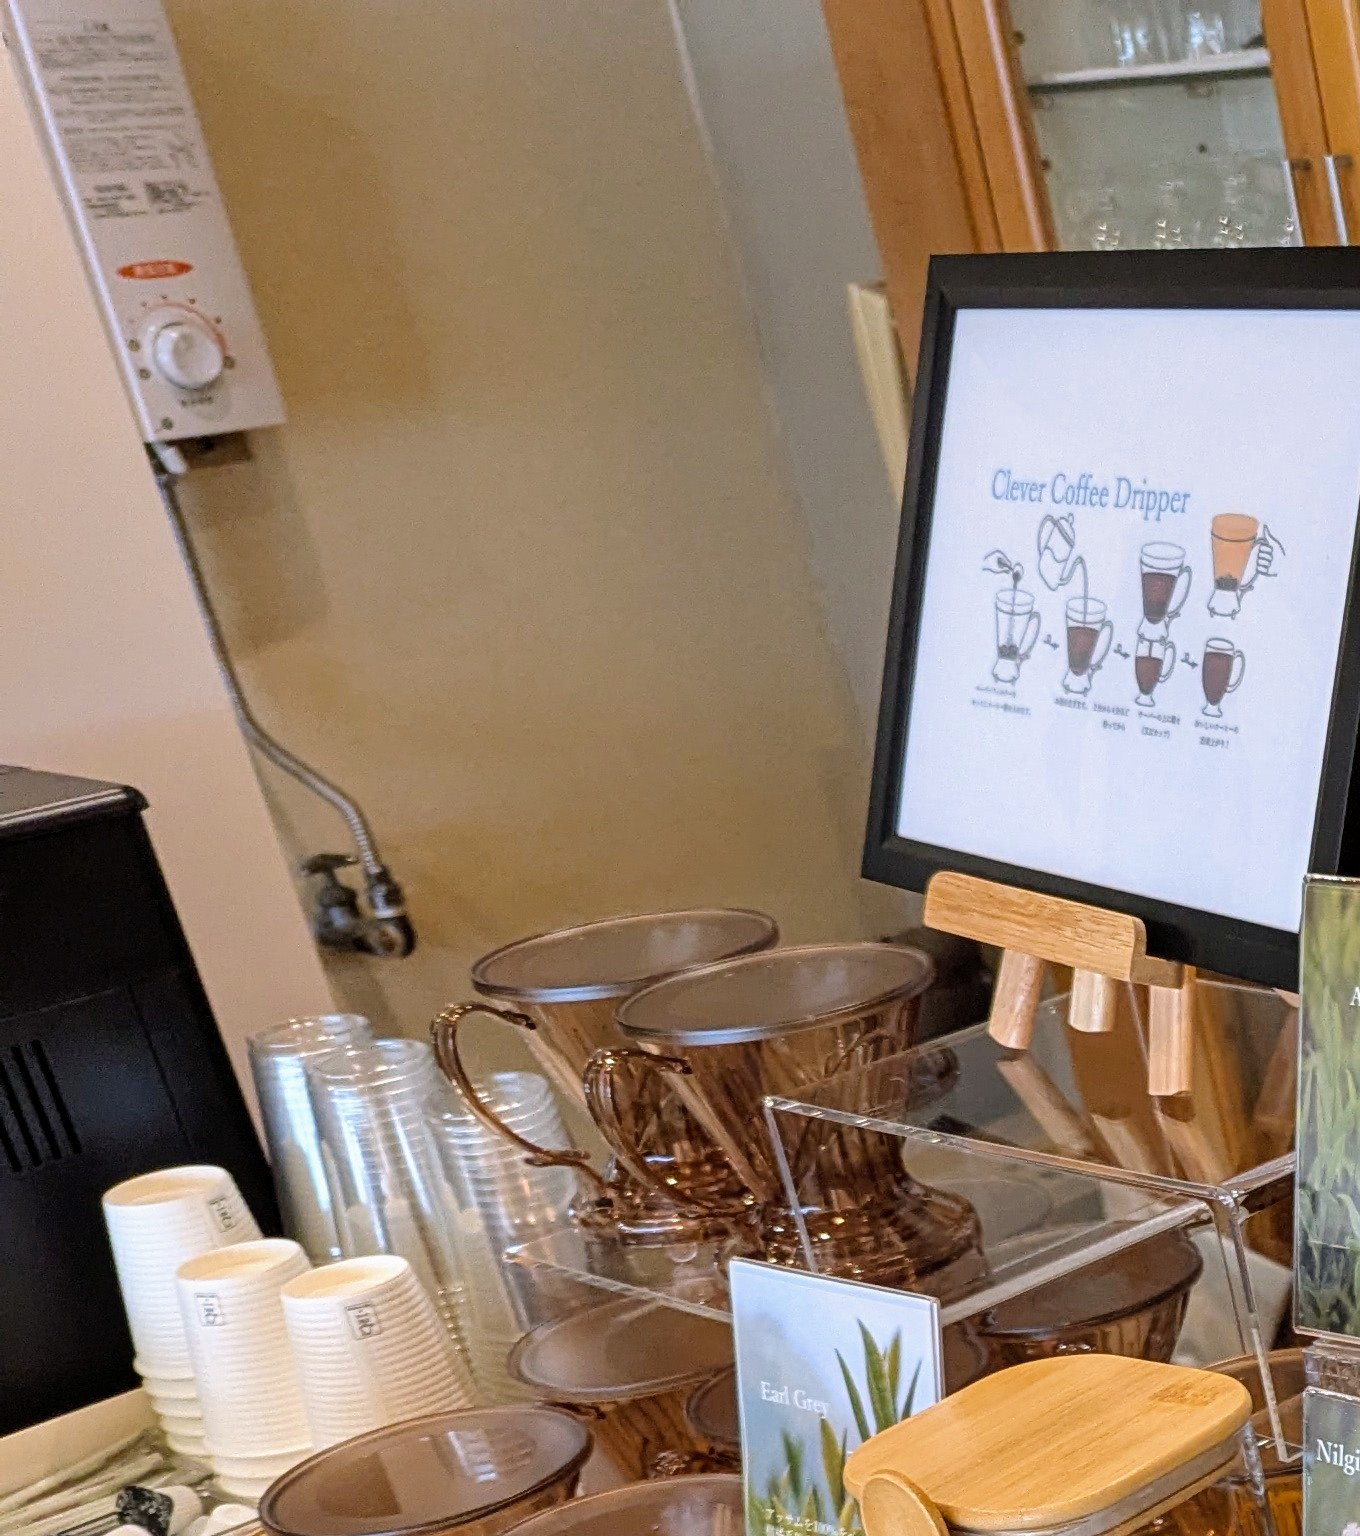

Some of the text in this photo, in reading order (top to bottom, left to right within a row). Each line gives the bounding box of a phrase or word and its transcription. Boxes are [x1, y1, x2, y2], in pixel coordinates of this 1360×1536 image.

[992, 468, 1191, 521] Clever Coffee Dripper
[759, 1380, 829, 1419] Earl Grey
